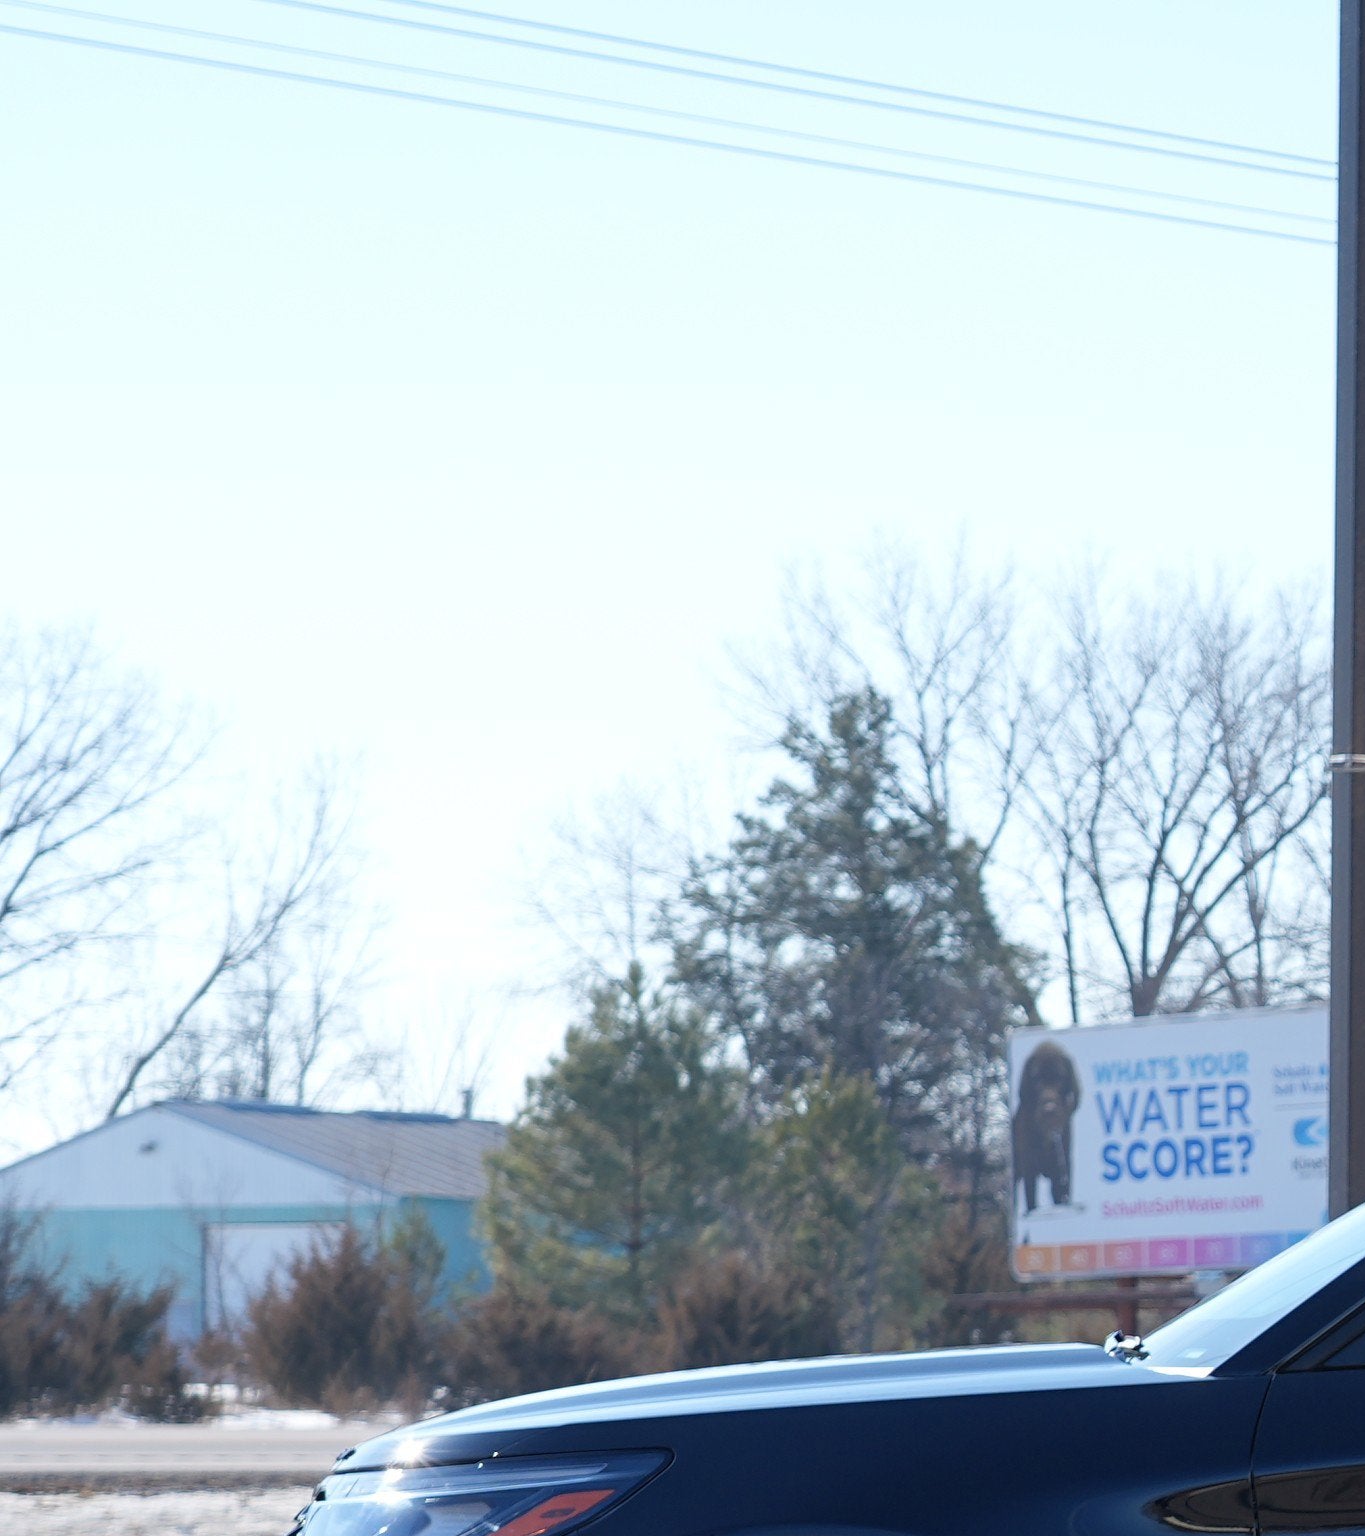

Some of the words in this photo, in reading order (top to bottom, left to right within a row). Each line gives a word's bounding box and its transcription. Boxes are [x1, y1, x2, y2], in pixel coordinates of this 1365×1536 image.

[1093, 1057, 1178, 1082] WHAT'S
[1187, 1050, 1249, 1076] YOUR
[1096, 1082, 1251, 1134] WATER
[1102, 1132, 1254, 1181] SCORE?
